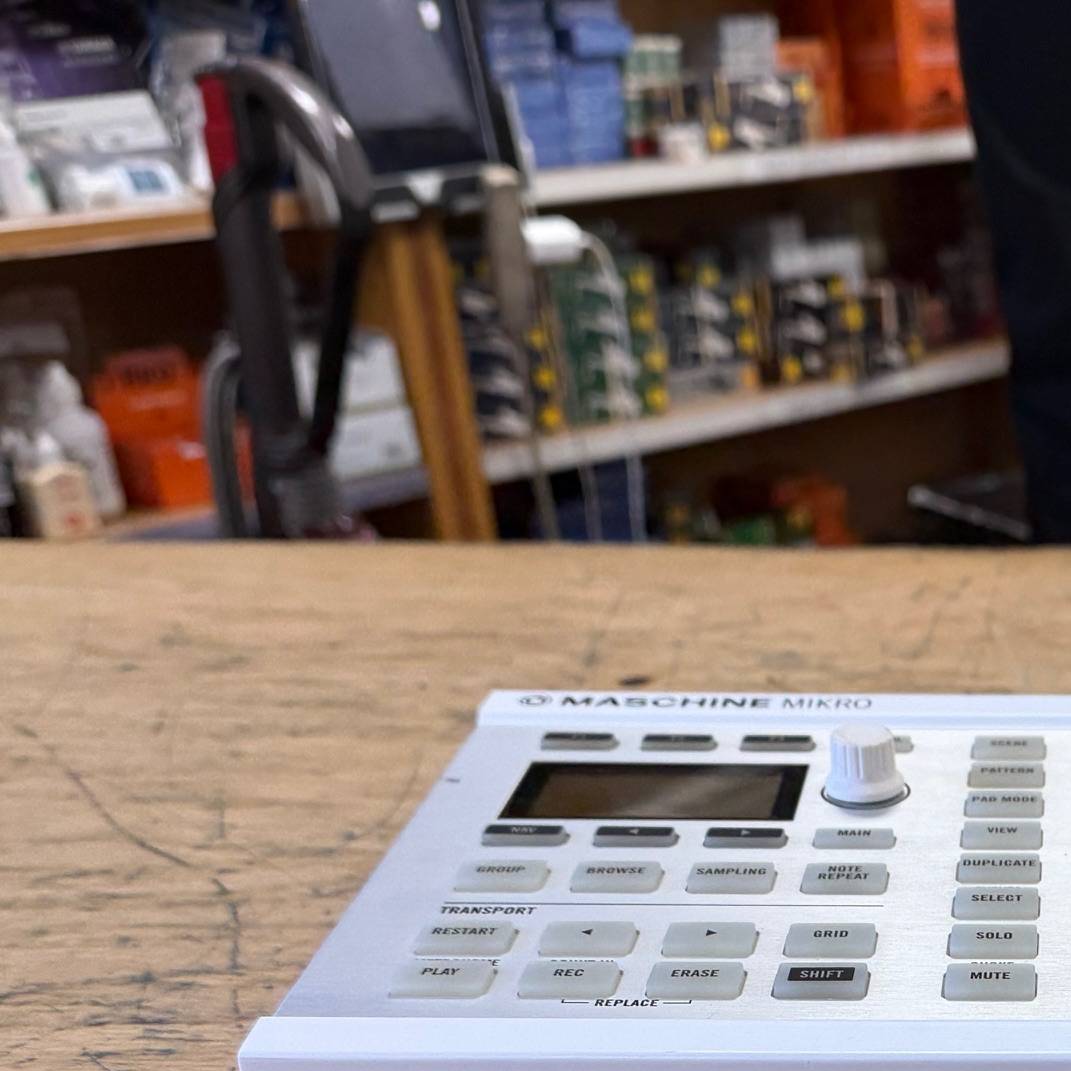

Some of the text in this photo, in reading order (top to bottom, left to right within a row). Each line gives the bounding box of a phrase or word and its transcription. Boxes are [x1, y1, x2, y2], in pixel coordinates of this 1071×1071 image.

[562, 696, 873, 710] MASCHINE MIKRO
[980, 766, 1035, 774] PATTERN
[971, 795, 1038, 803] PAD MODE
[837, 829, 872, 837] MAIN
[986, 826, 1018, 834] VIEW
[962, 859, 1037, 867] DUPLICATE
[475, 865, 527, 873] GROUP
[585, 865, 646, 875] BROWSE
[695, 866, 768, 876] SAMPLING
[827, 865, 863, 873] NOTE
[817, 872, 870, 881] REPEAT
[970, 894, 1023, 902] SELECT
[440, 906, 537, 916] TRANSPORT
[431, 927, 499, 936] RESTART
[813, 930, 849, 938] GRID
[976, 931, 1013, 940] SOLO
[420, 967, 460, 976] PLAY
[553, 968, 585, 977] REC
[670, 969, 720, 978] ERASE
[799, 970, 844, 979] SHIFT
[969, 971, 1011, 980] MUTE
[593, 999, 660, 1007] REPLACE
